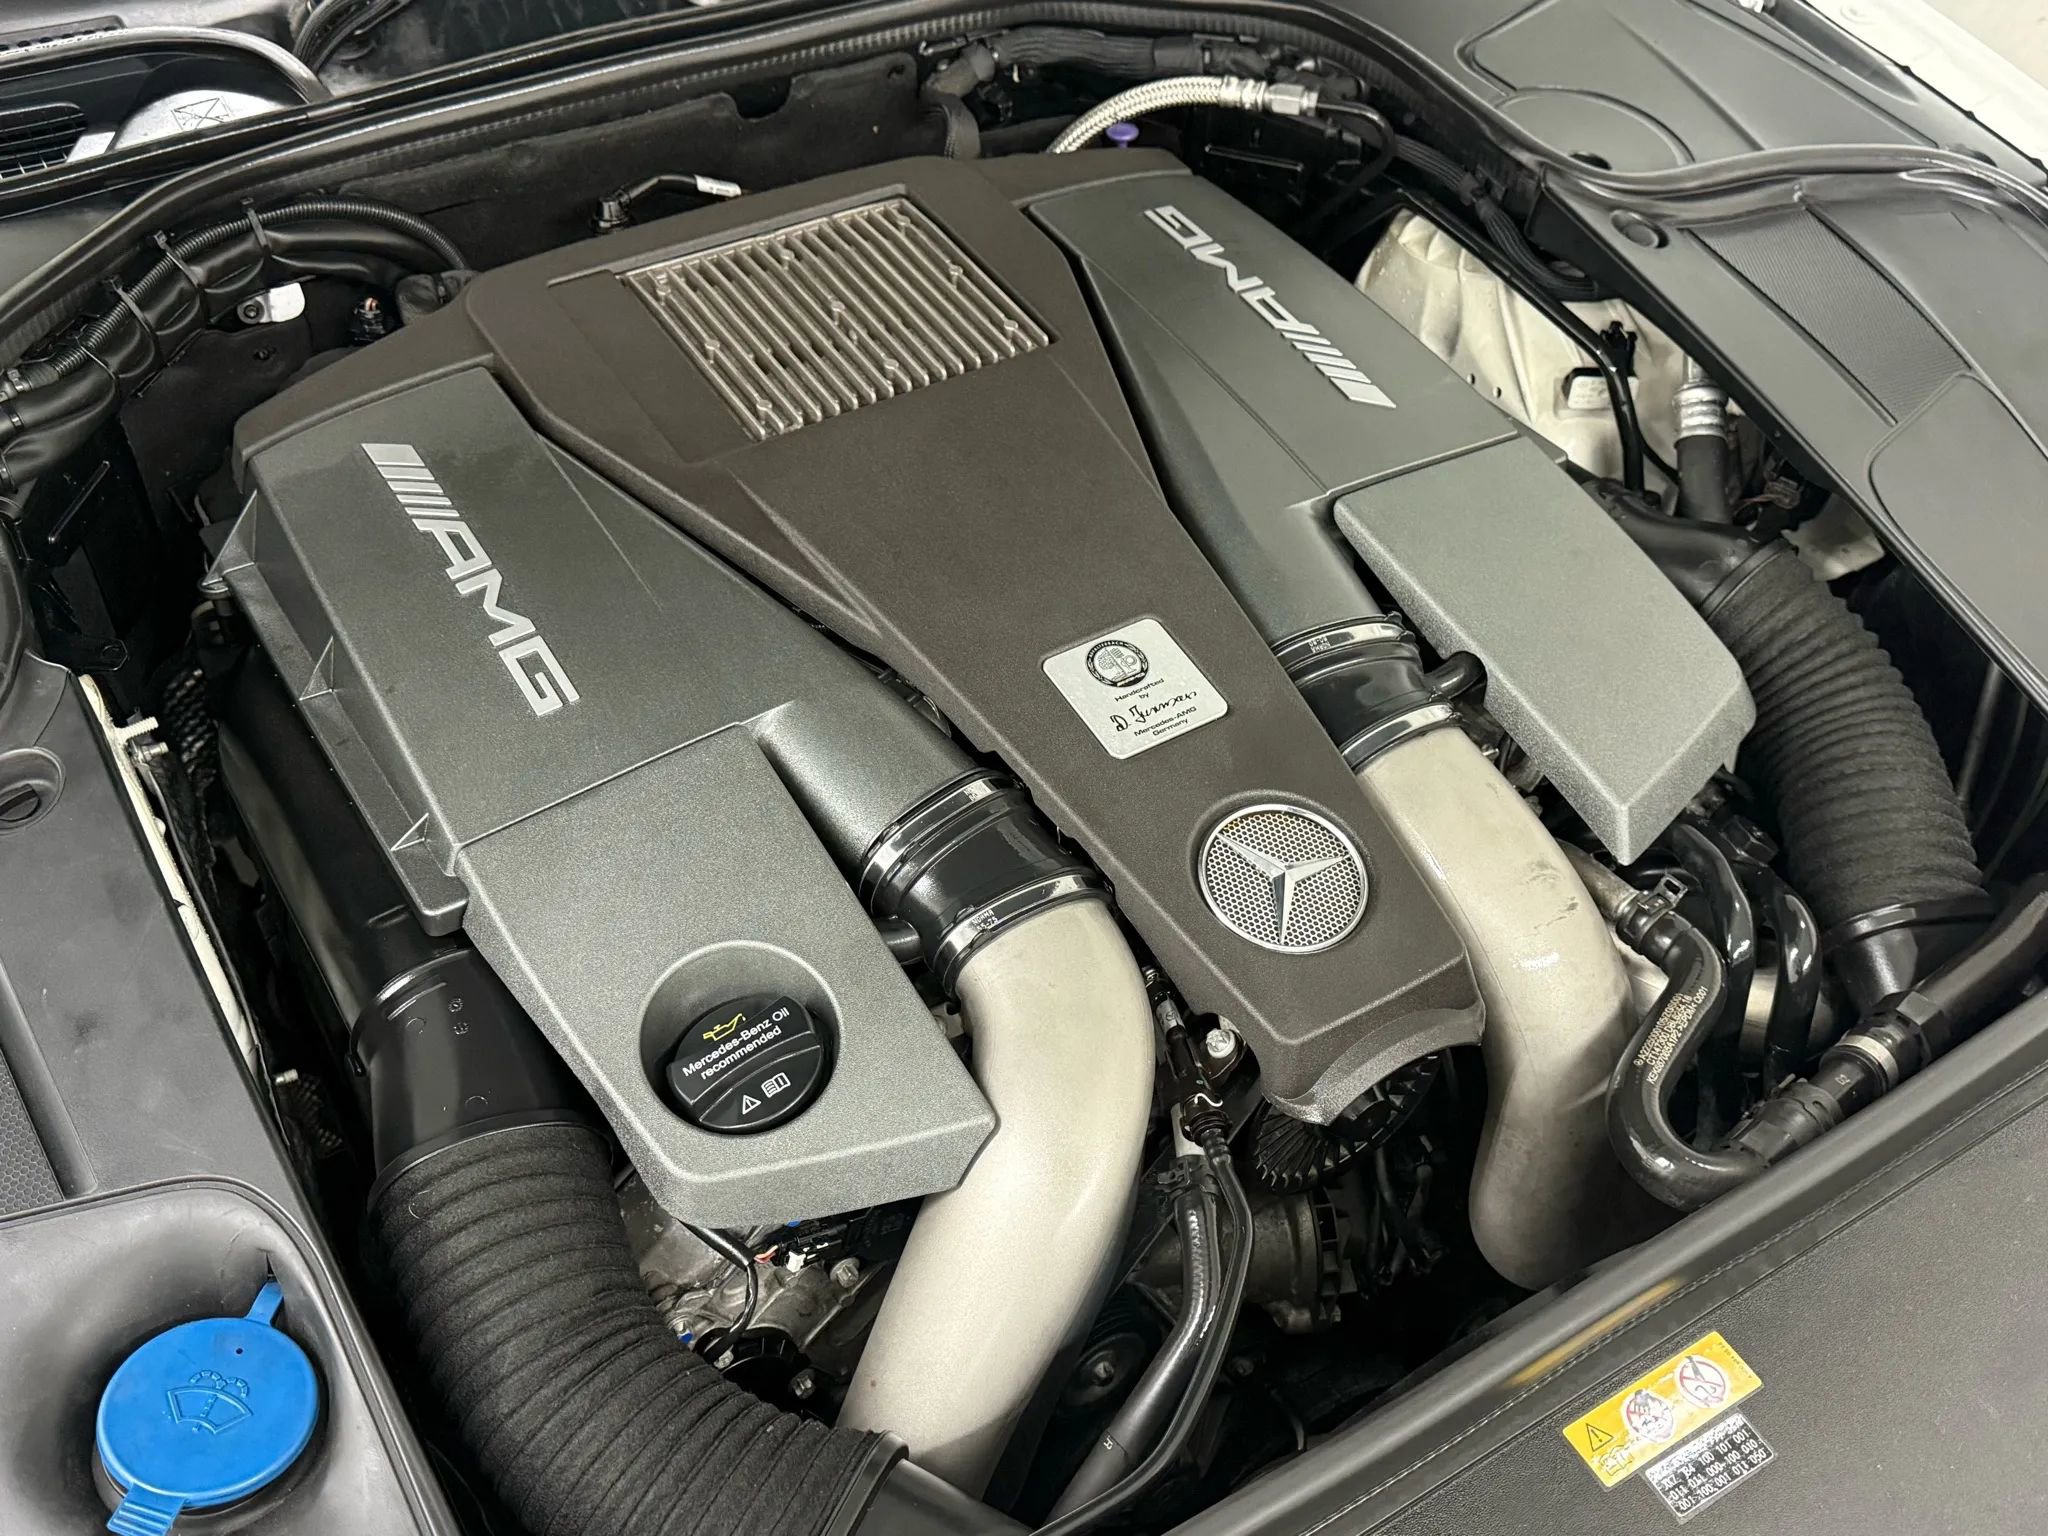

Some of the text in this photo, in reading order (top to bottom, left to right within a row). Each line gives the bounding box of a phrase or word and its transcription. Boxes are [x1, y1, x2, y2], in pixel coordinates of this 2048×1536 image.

[1144, 205, 1320, 335] AMG
[412, 518, 580, 716] AMG
[1115, 678, 1165, 702] Handcrafted
[1139, 692, 1150, 701] by
[1134, 706, 1197, 737] Mercedes-AMG
[1152, 718, 1188, 736] Germany
[682, 1007, 790, 1077] Mercedes-Benz Oil
[700, 1026, 782, 1080] recommended
[1733, 1429, 1750, 1443] 001
[1706, 1462, 1723, 1477] 000
[1726, 1450, 1741, 1465] 100
